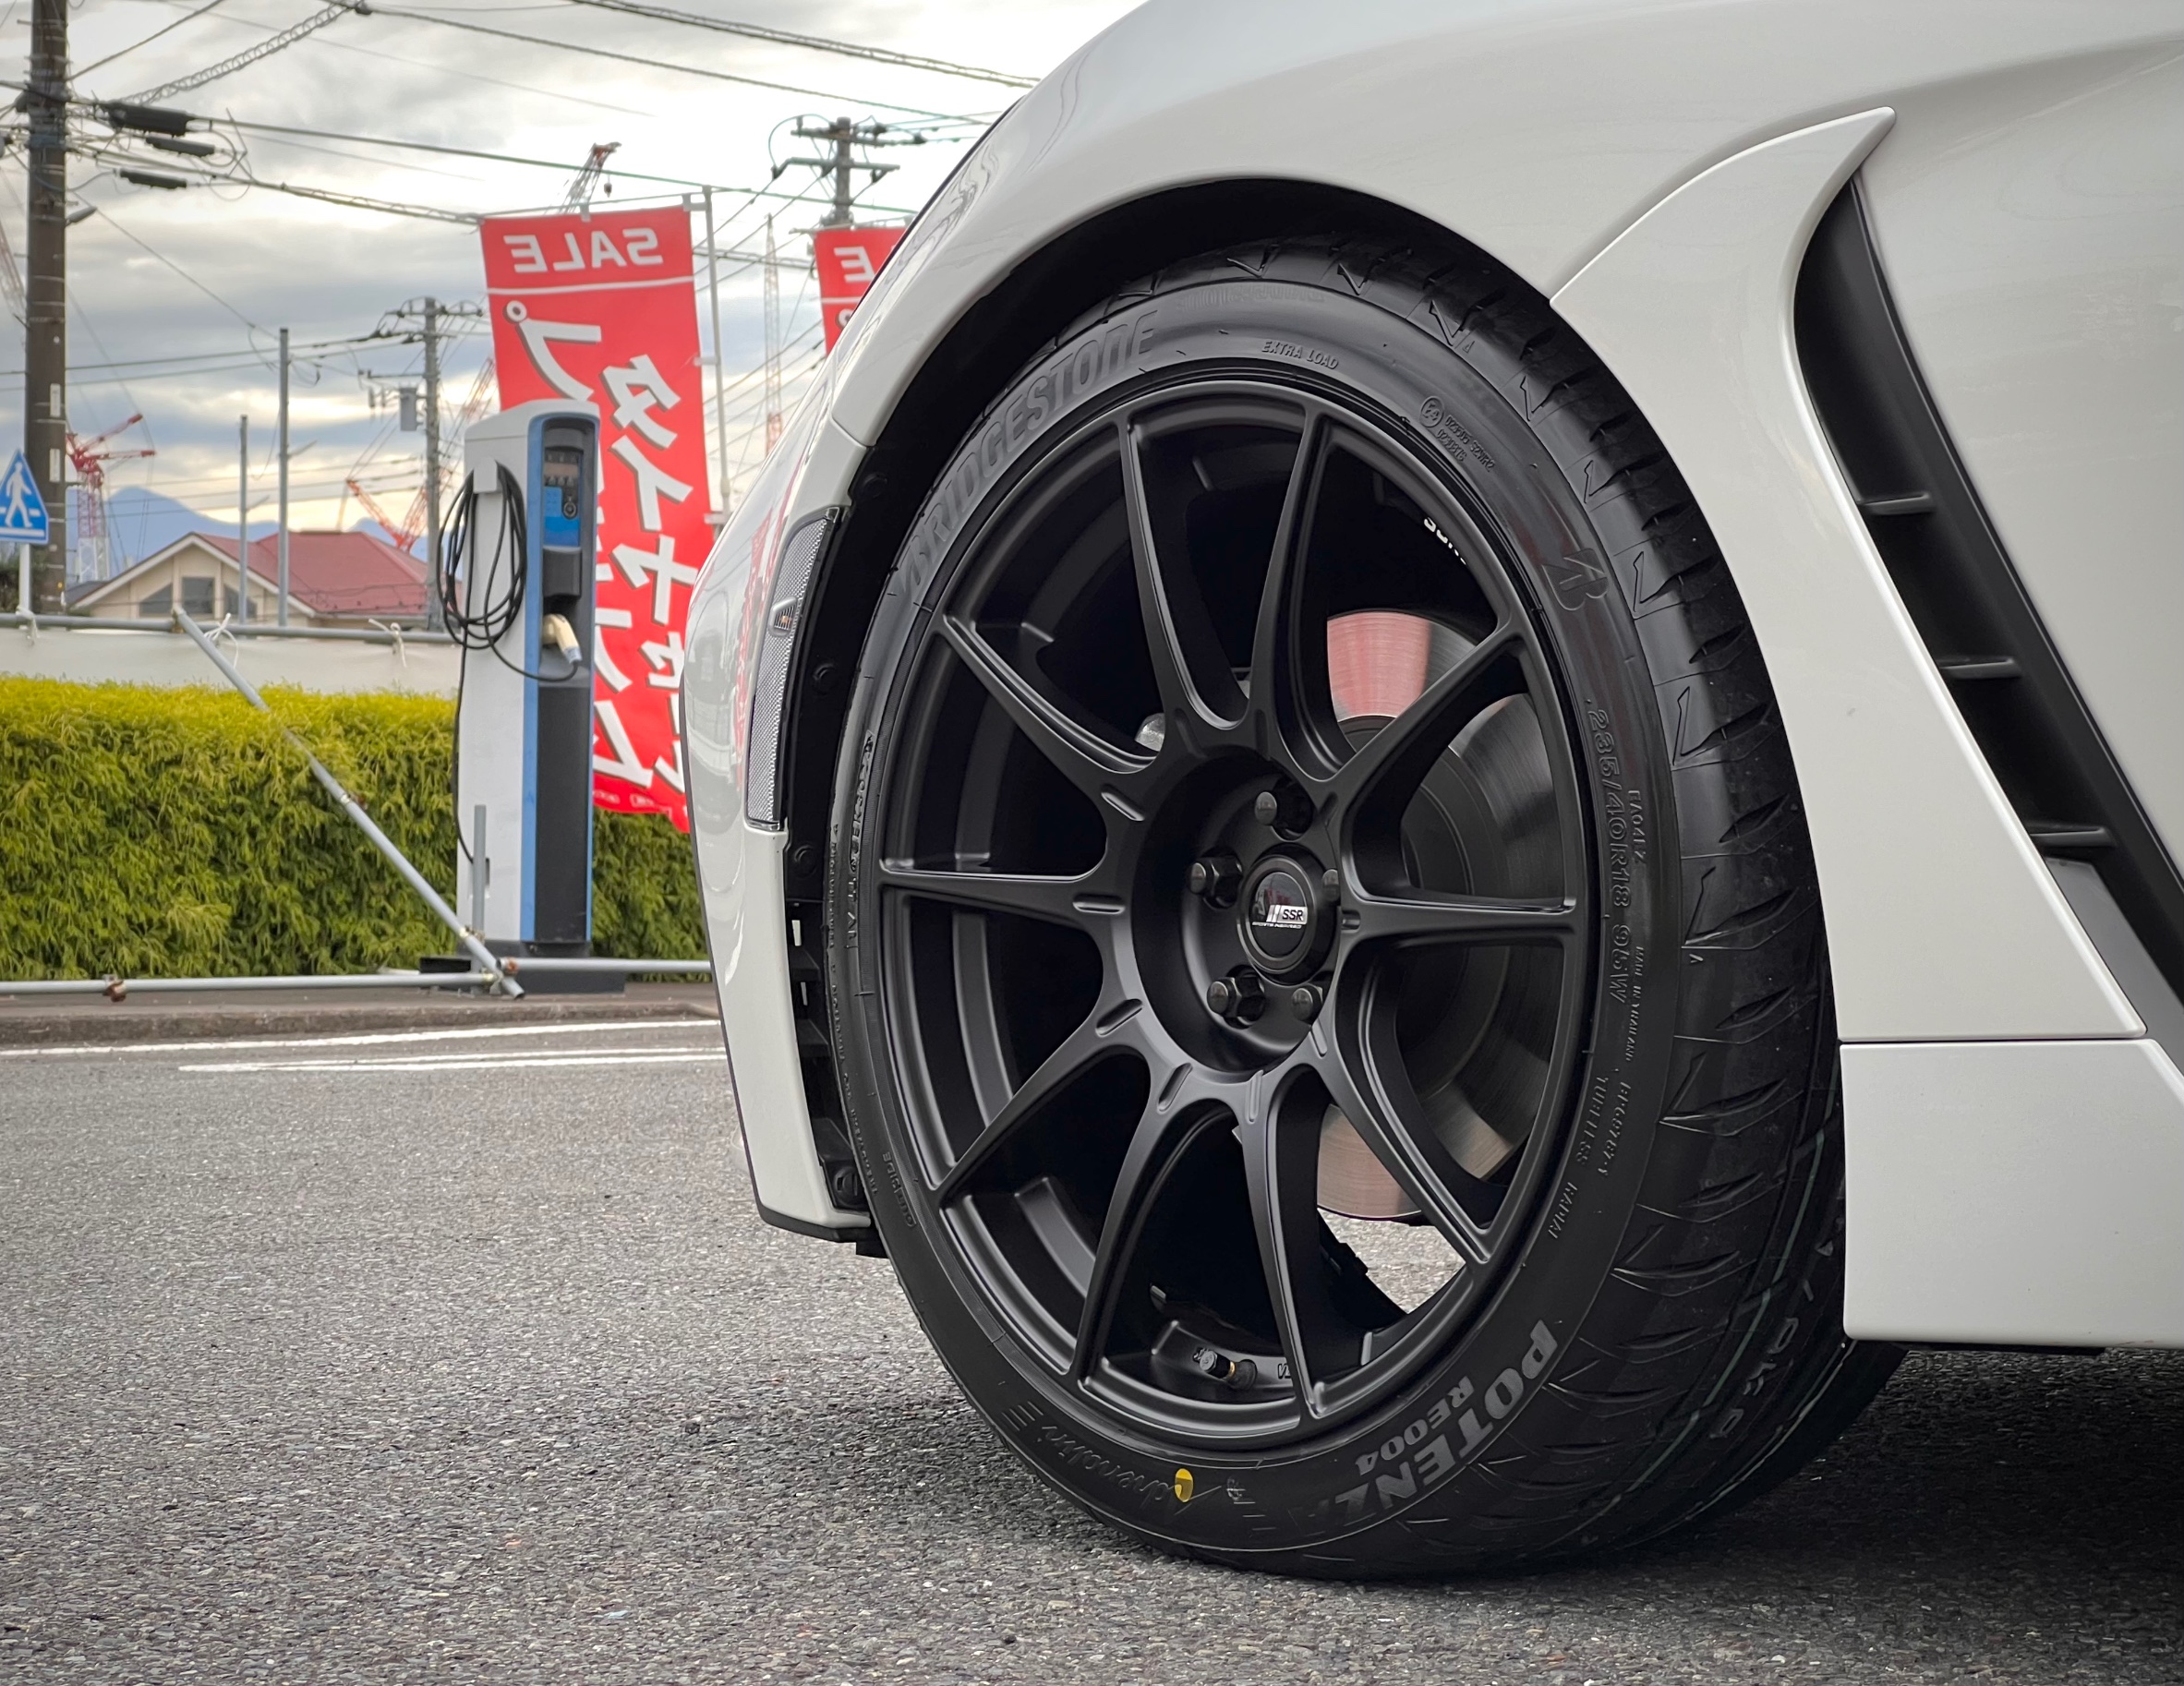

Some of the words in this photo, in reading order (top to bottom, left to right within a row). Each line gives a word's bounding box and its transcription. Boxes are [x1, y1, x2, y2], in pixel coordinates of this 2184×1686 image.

[1261, 339, 1302, 359] EXTRA
[1306, 348, 1339, 369] LOAD
[1587, 708, 1632, 909] 235/40R18
[1282, 909, 1303, 921] SSR
[1355, 1376, 1474, 1476] RE004
